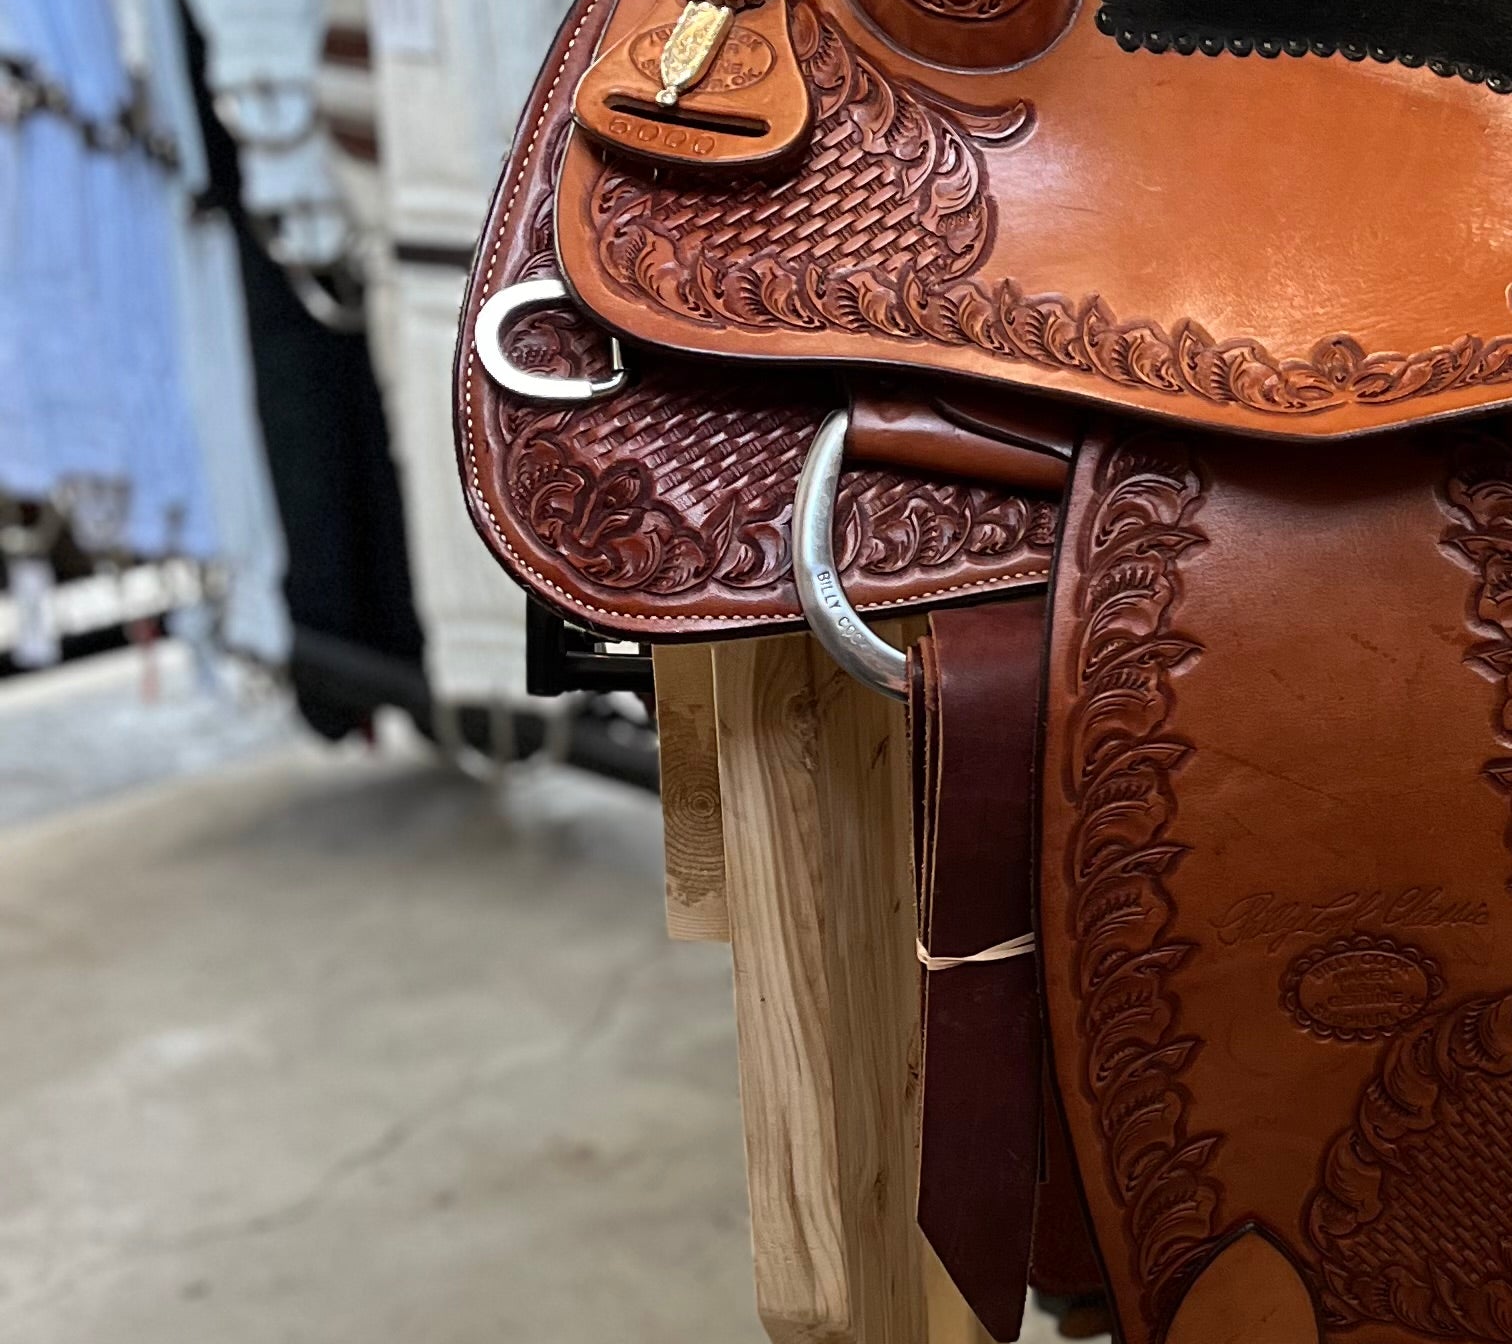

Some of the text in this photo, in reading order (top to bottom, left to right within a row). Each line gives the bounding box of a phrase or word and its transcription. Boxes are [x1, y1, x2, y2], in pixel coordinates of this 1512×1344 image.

[817, 571, 841, 608] BILLY
[1311, 953, 1413, 980] BILLY COOK
[1332, 969, 1393, 983] MAKER
